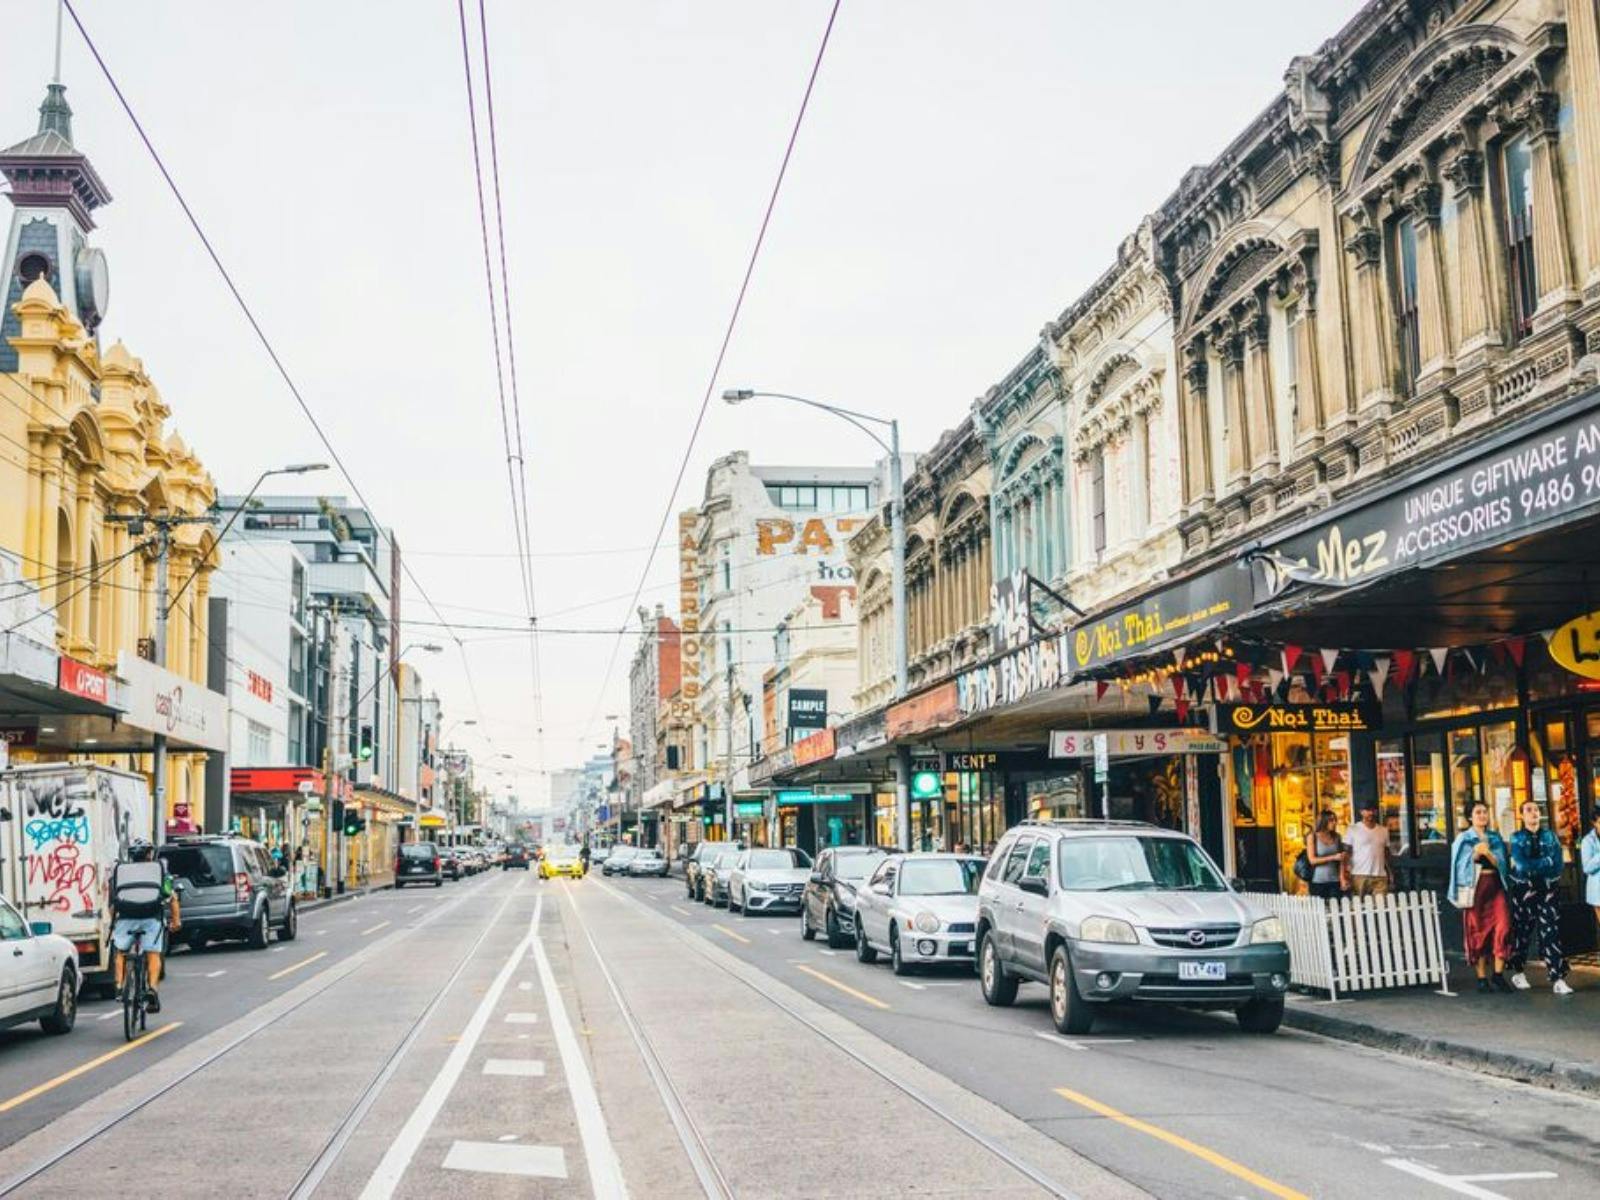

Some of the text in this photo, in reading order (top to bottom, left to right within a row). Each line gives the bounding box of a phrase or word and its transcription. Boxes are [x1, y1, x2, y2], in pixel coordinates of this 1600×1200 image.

[1405, 477, 1464, 524] UNIQUE
[1471, 436, 1568, 497] GIFTWARE
[1394, 496, 1512, 560] ACCESSORIES
[1520, 473, 1575, 517] 9486
[1310, 524, 1389, 584] Mez
[1096, 621, 1122, 658] Noi
[1124, 603, 1164, 646] Thai
[791, 700, 824, 711] SAMPLE
[1269, 708, 1363, 729] Noi Thai
[952, 754, 986, 769] KENT
